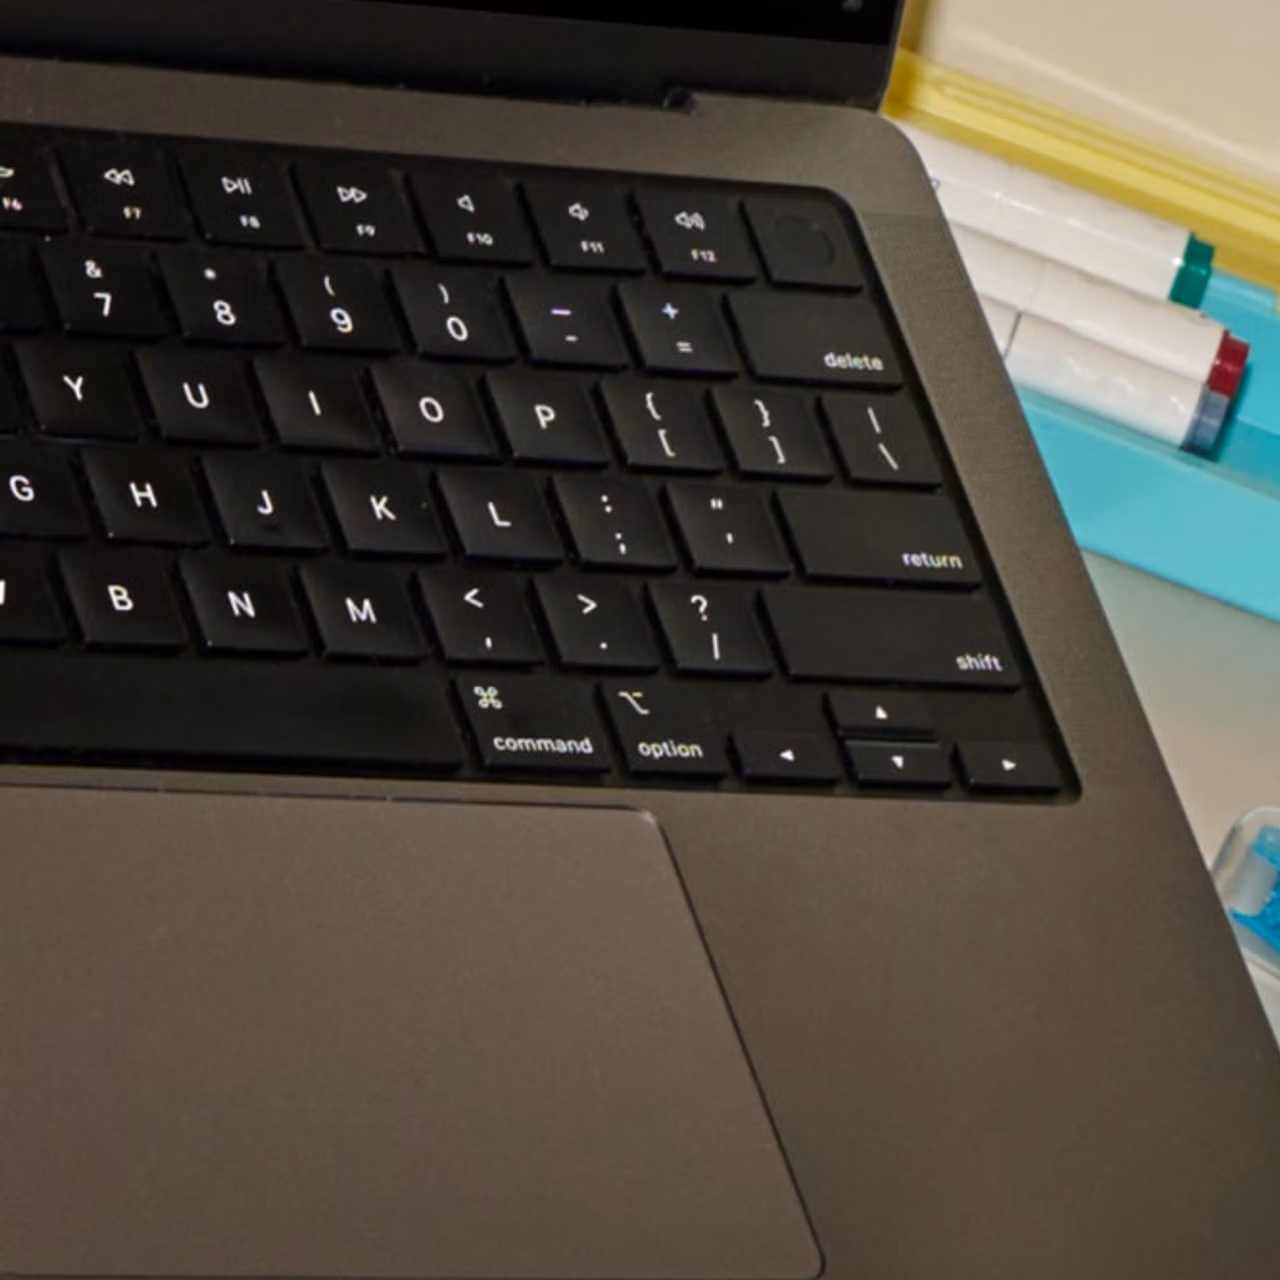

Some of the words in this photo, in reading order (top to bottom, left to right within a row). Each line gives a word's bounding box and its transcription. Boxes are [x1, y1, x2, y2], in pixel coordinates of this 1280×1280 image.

[93, 292, 112, 317] 7
[213, 299, 237, 326] 8
[330, 307, 353, 333] 9
[446, 316, 469, 342] 0
[823, 351, 884, 371] delete
[63, 375, 84, 401] Y
[182, 382, 210, 409] U
[534, 404, 556, 429] P
[9, 474, 35, 502] G
[129, 482, 158, 508] H
[257, 489, 274, 515] J
[370, 495, 396, 521] K
[487, 501, 512, 527] L
[901, 552, 963, 569] return
[107, 584, 134, 611] B
[227, 591, 256, 618] N
[345, 597, 377, 623] M
[955, 653, 1003, 672] shift
[492, 736, 594, 754] command
[637, 739, 703, 759] option
